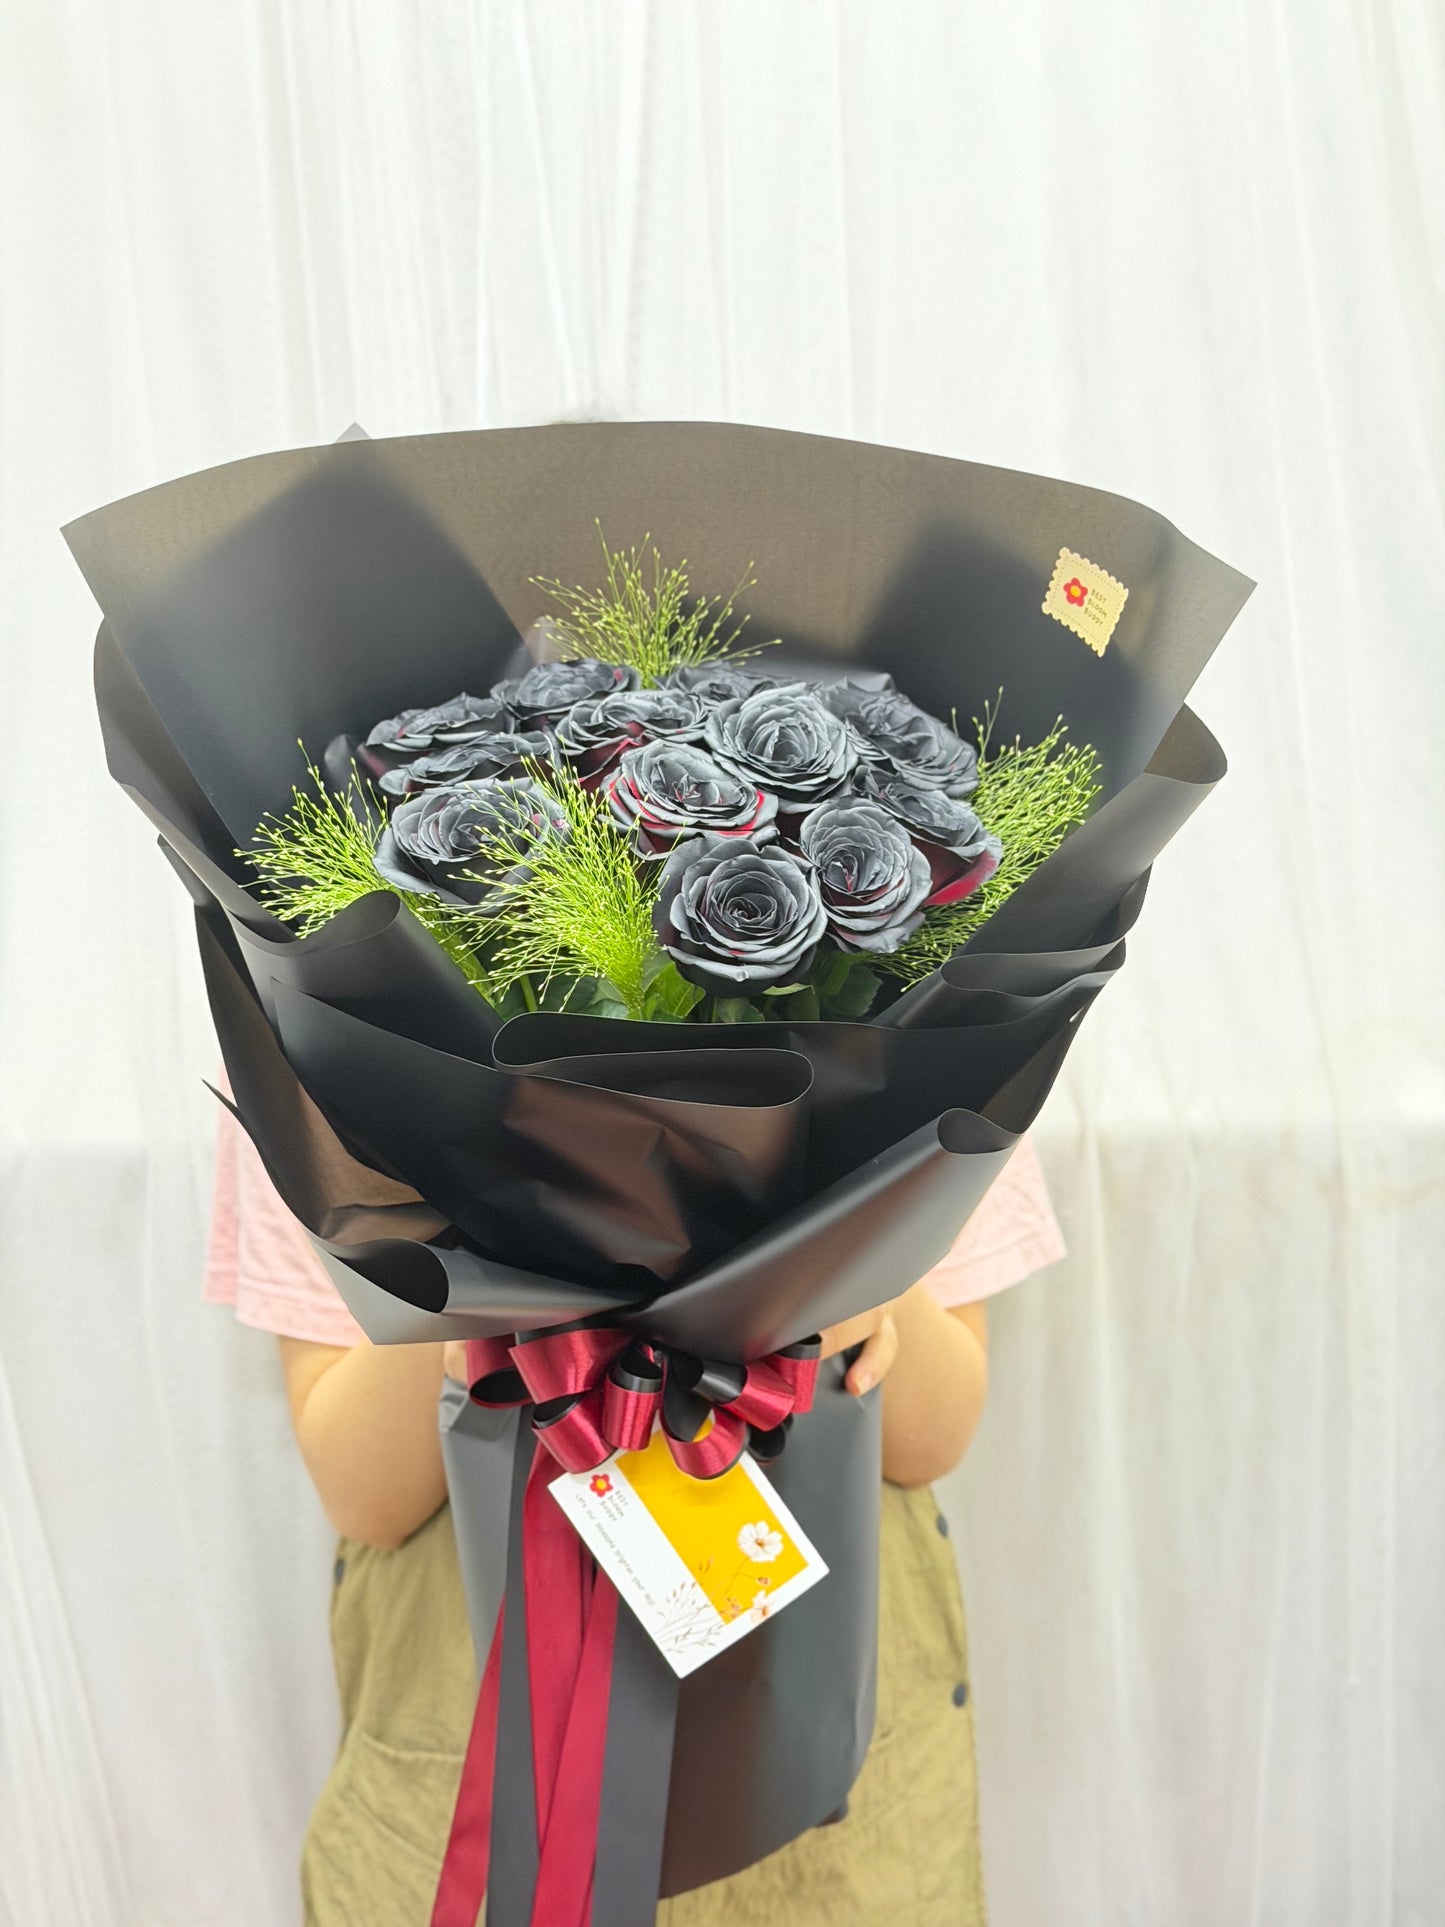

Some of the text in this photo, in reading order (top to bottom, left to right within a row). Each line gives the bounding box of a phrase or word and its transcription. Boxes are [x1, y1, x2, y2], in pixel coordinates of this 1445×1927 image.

[1091, 588, 1107, 604] BEST
[1083, 607, 1103, 625] BUDDY
[1087, 598, 1107, 618] BLOOM
[608, 1495, 624, 1517] BLOOM
[615, 1490, 628, 1506] BEST
[600, 1501, 618, 1521] BUDDY
[586, 1509, 596, 1520] our
[615, 1549, 633, 1574] brighten
